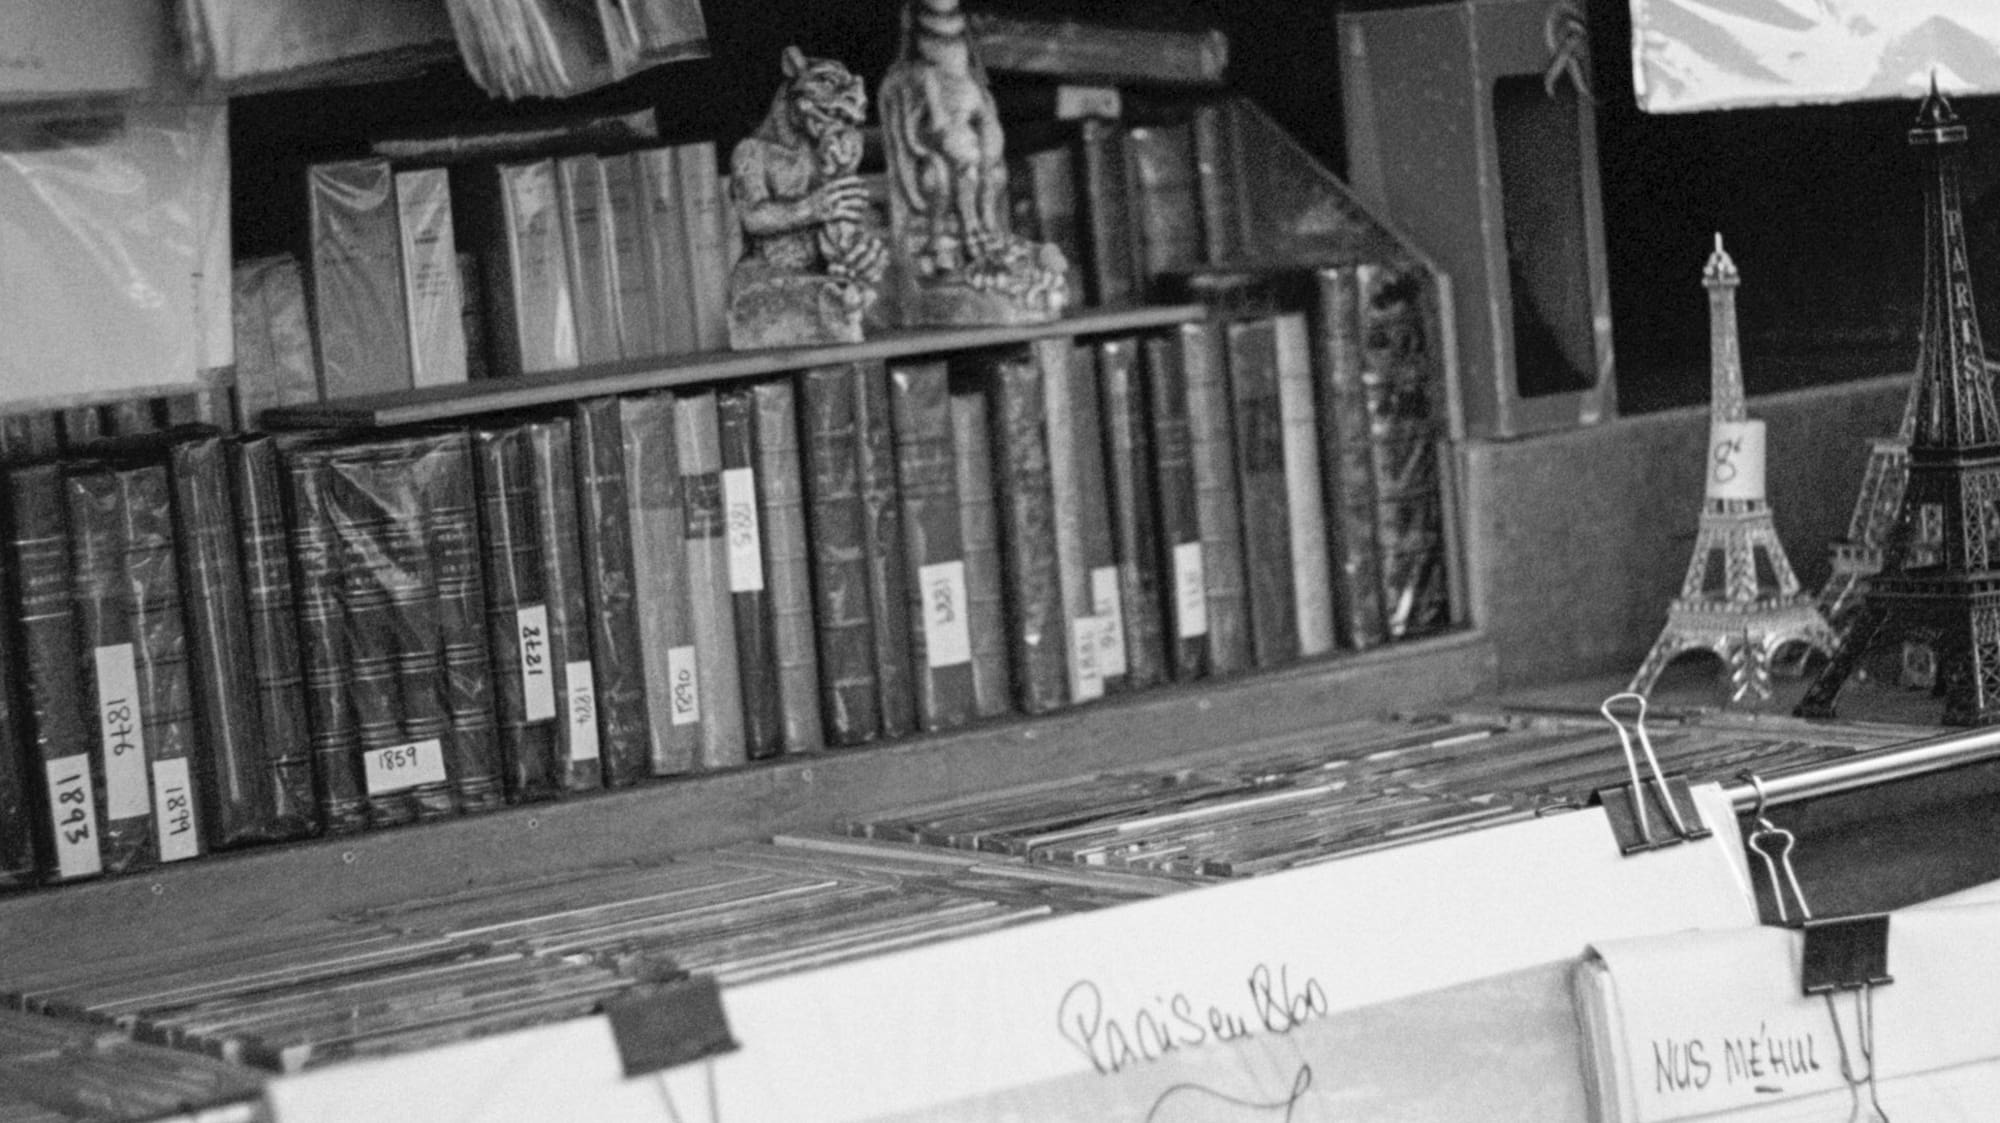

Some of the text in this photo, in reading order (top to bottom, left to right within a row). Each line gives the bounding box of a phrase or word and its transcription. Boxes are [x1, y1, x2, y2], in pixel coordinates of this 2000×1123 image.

[1948, 209, 1980, 381] PARIS
[522, 625, 544, 676] 1878
[105, 697, 135, 757] 1876
[378, 745, 417, 771] 1859
[55, 773, 90, 845] 1893
[164, 786, 191, 836] 1899
[1651, 1037, 1712, 1094] NUS
